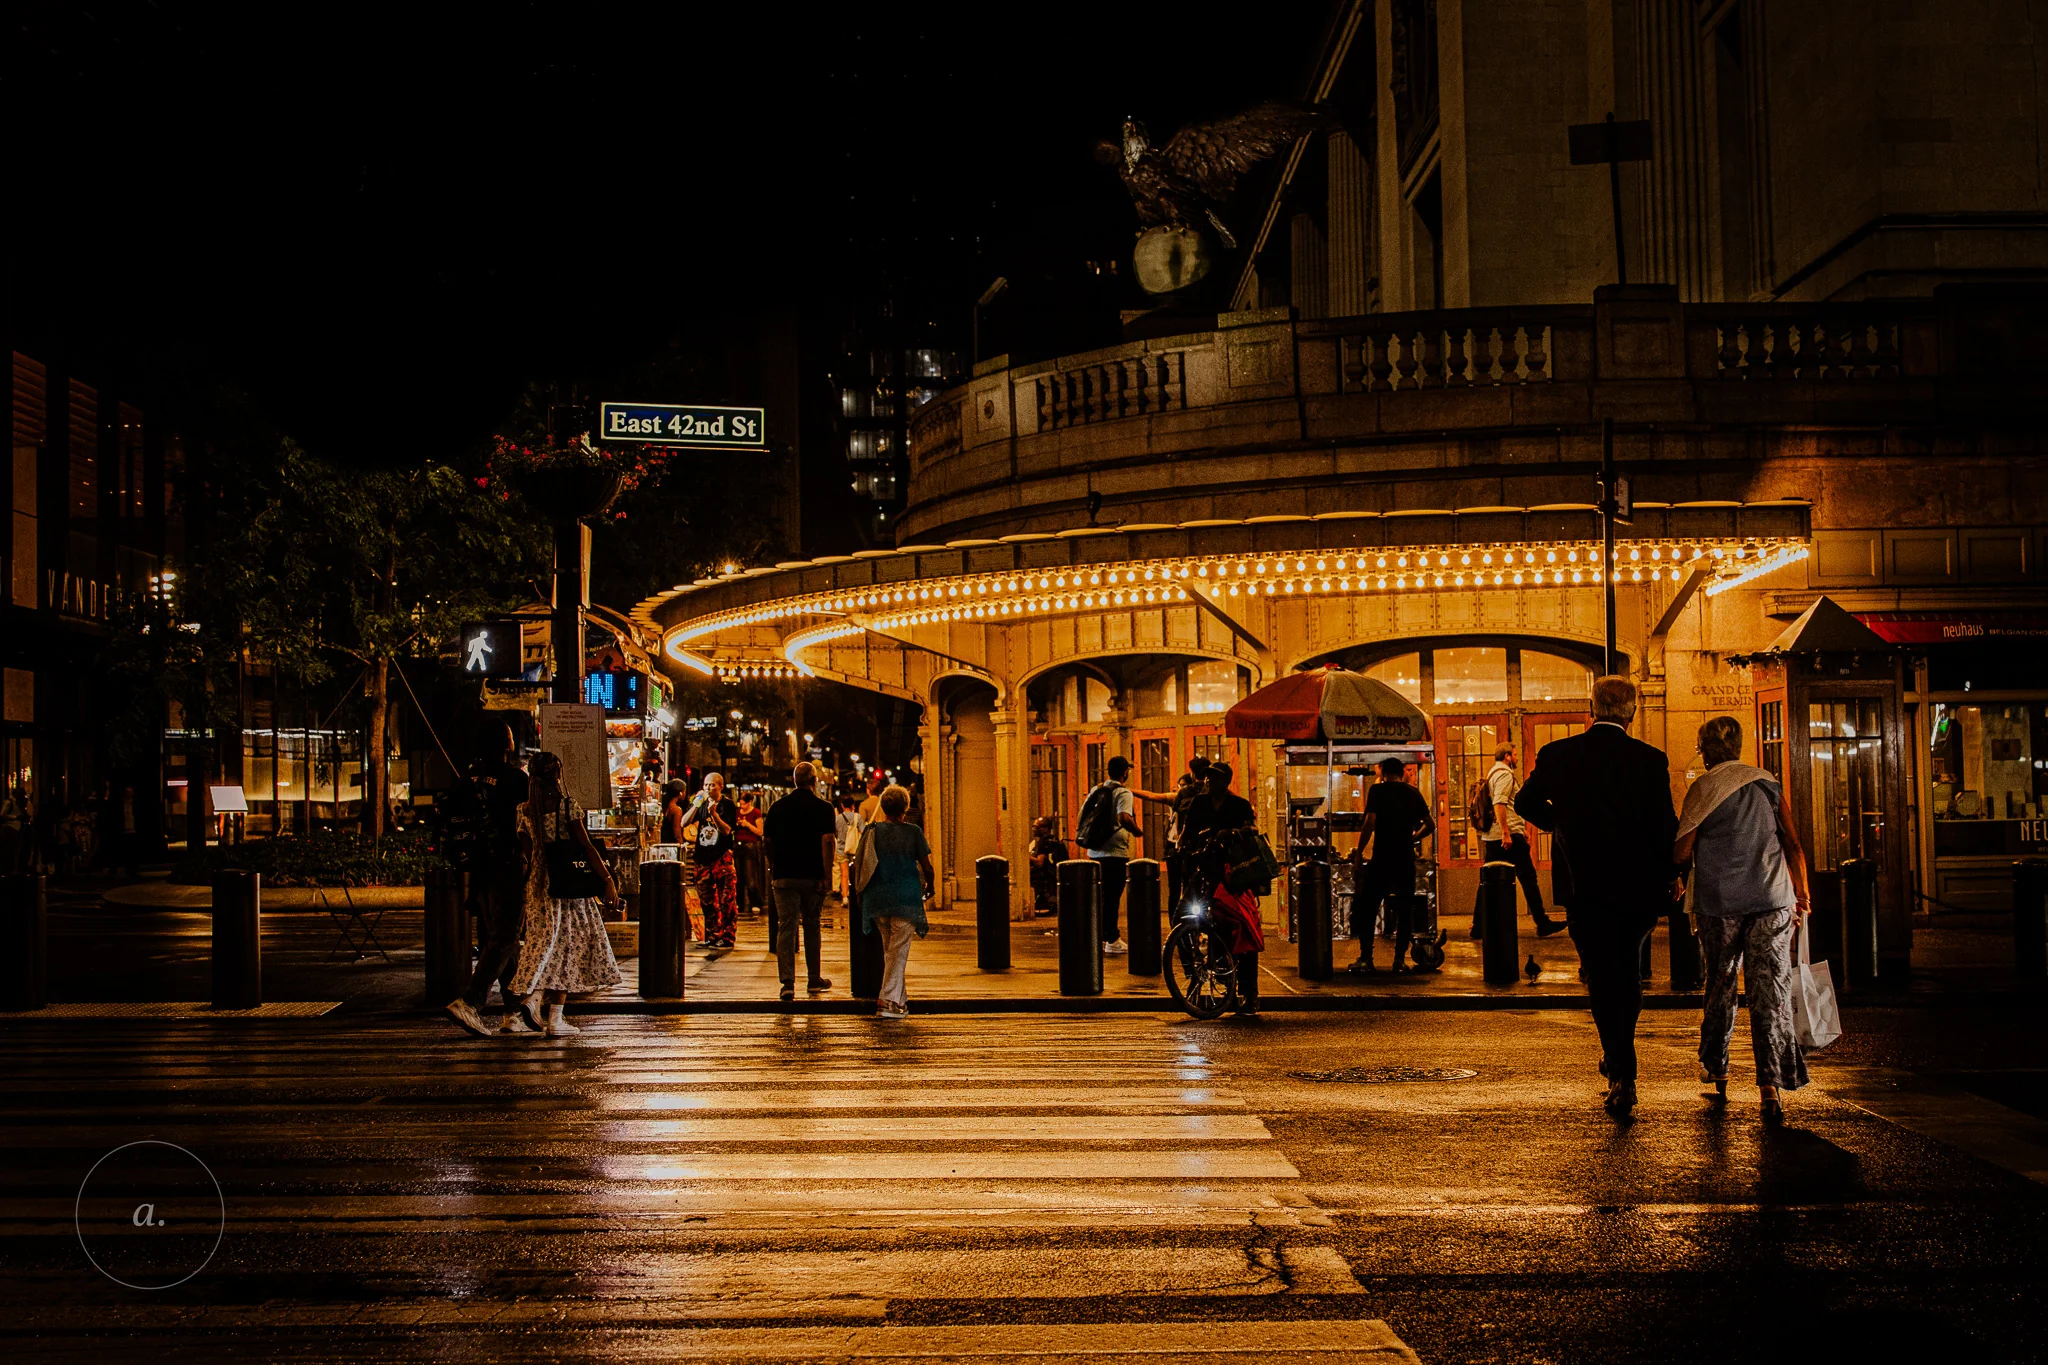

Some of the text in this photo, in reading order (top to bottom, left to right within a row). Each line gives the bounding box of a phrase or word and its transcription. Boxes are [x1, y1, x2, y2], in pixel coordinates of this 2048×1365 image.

[609, 411, 757, 437] East 42nd St
[1943, 621, 1984, 638] neuhaus
[1988, 628, 2028, 636] BELGIAN
[1691, 685, 1735, 696] GRAND
